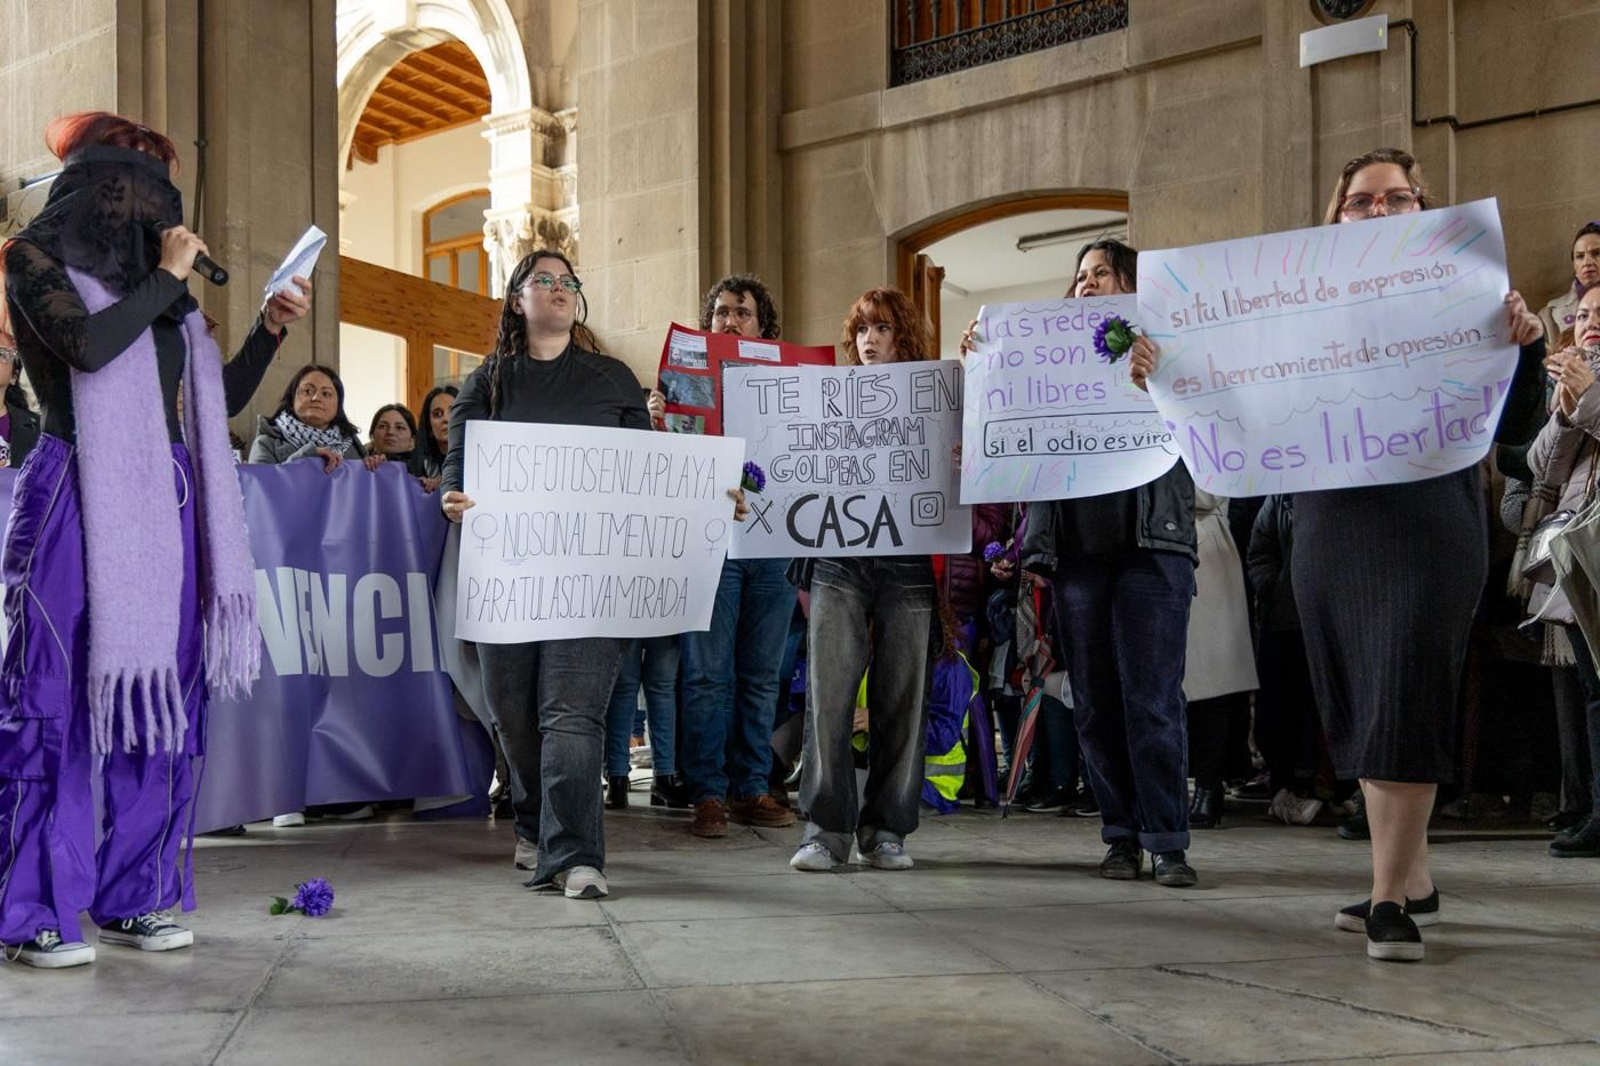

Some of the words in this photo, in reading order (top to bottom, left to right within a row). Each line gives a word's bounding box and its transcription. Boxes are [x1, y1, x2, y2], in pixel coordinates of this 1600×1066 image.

[1170, 308, 1190, 328] si
[1192, 292, 1219, 323] tu
[1222, 278, 1309, 317] libertad
[1315, 276, 1339, 302] de
[1347, 261, 1458, 299] expresión
[984, 317, 1034, 342] las
[986, 349, 1024, 371] no
[1034, 345, 1086, 366] son
[1172, 376, 1202, 395] es
[1207, 340, 1353, 389] herramienta
[1355, 338, 1380, 363] de
[746, 376, 800, 415] TE
[822, 369, 898, 419] RÍES
[910, 367, 961, 414] EN
[986, 381, 1013, 411] ni
[1027, 374, 1106, 404] libres
[787, 416, 926, 451] INSTAGRAM
[990, 439, 1005, 455] si
[1017, 427, 1034, 452] el
[1047, 430, 1098, 452] odio
[1104, 435, 1128, 449] es
[1132, 433, 1172, 447] vira
[1166, 420, 1245, 473] No
[1261, 445, 1306, 470] es
[769, 452, 876, 486] GOLPEAS
[889, 450, 930, 482] EN
[785, 494, 904, 549] CASA
